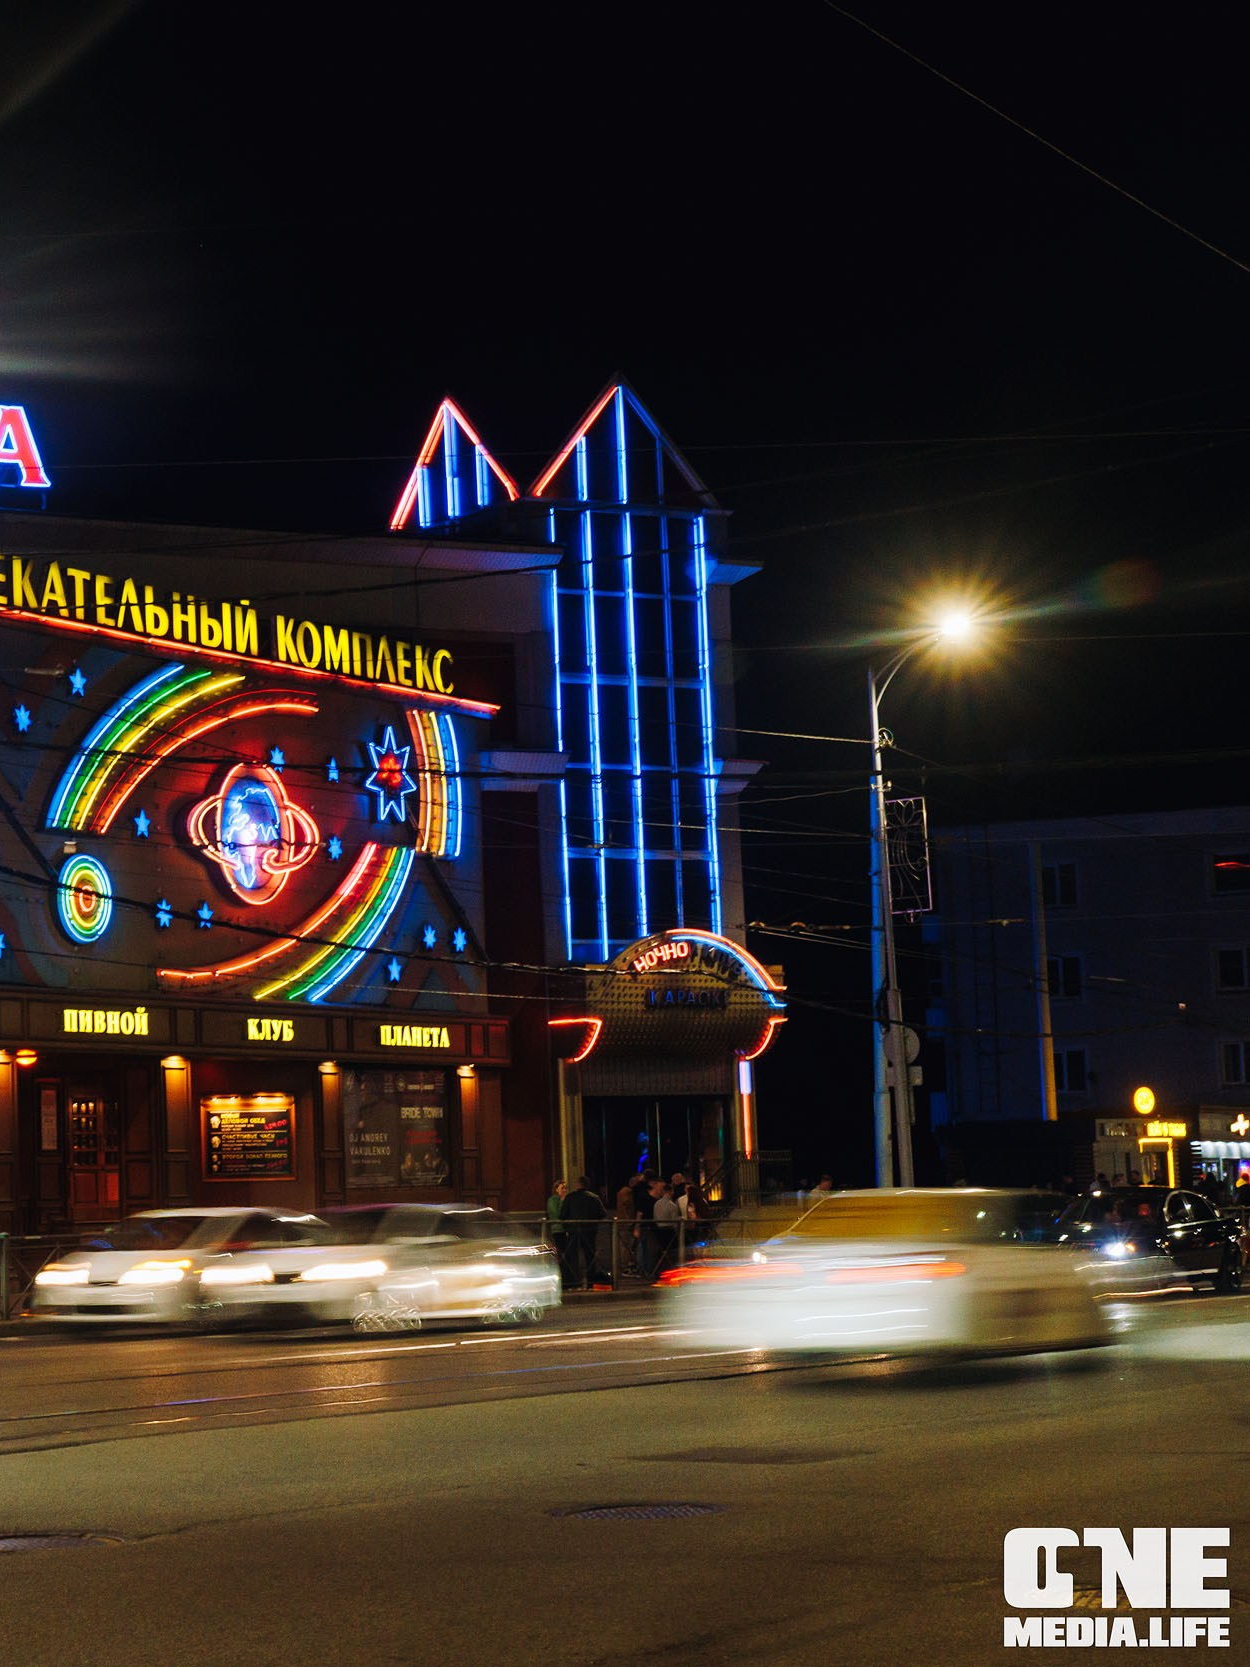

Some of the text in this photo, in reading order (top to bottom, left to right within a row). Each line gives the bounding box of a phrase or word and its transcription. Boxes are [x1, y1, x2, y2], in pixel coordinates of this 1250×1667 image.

[277, 614, 454, 694] КОМПЛЕКС
[64, 1007, 149, 1035] ПИВНОЙ
[247, 1019, 295, 1042] КЛУБ
[380, 1025, 450, 1048] ПЛАНЕТА
